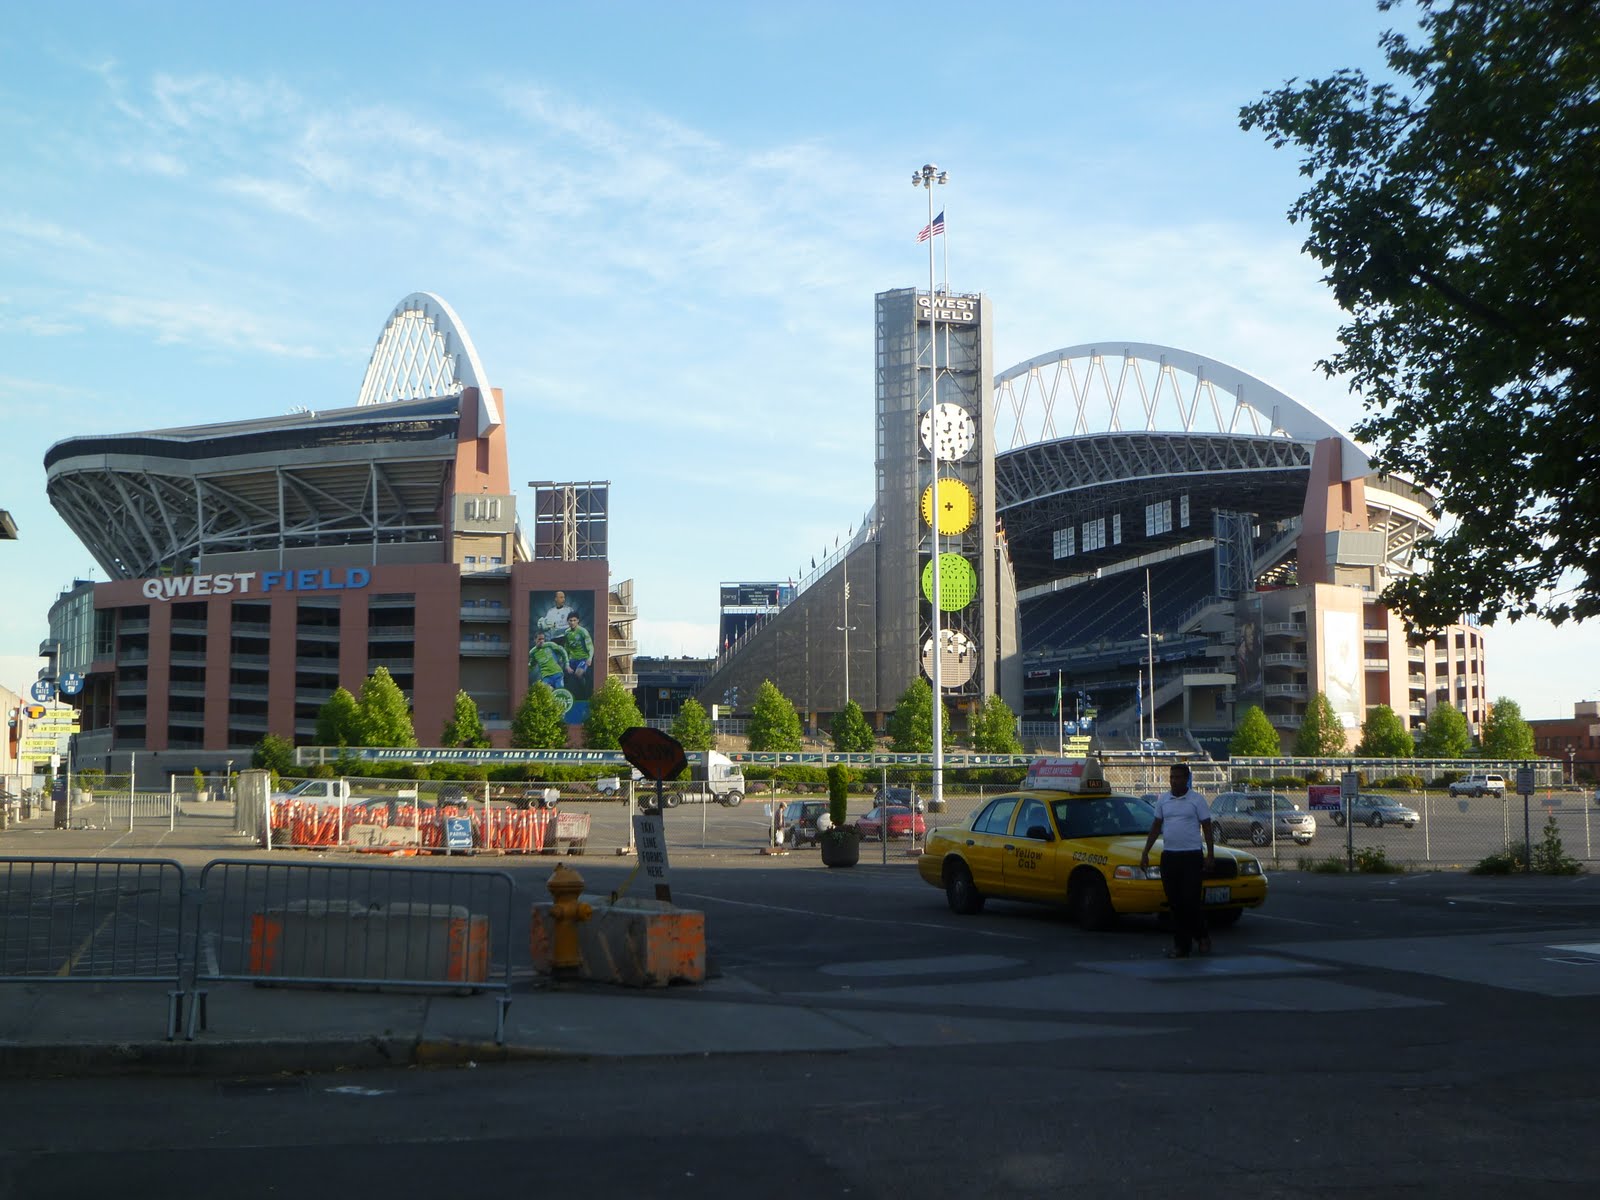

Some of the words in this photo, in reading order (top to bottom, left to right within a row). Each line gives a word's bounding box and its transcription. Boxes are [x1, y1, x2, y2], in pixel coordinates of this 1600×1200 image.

[918, 297, 977, 310] QWEST
[923, 309, 974, 321] FIELD
[142, 571, 256, 601] QWEST
[261, 568, 370, 592] FIELD
[435, 750, 463, 758] QWEST
[543, 751, 558, 759] THE
[640, 821, 656, 834] TAXI
[642, 836, 657, 849] LINE
[642, 851, 664, 864] FORMS
[1015, 847, 1043, 860] Yellow
[1018, 859, 1037, 870] Cab
[646, 867, 664, 879] HERE
